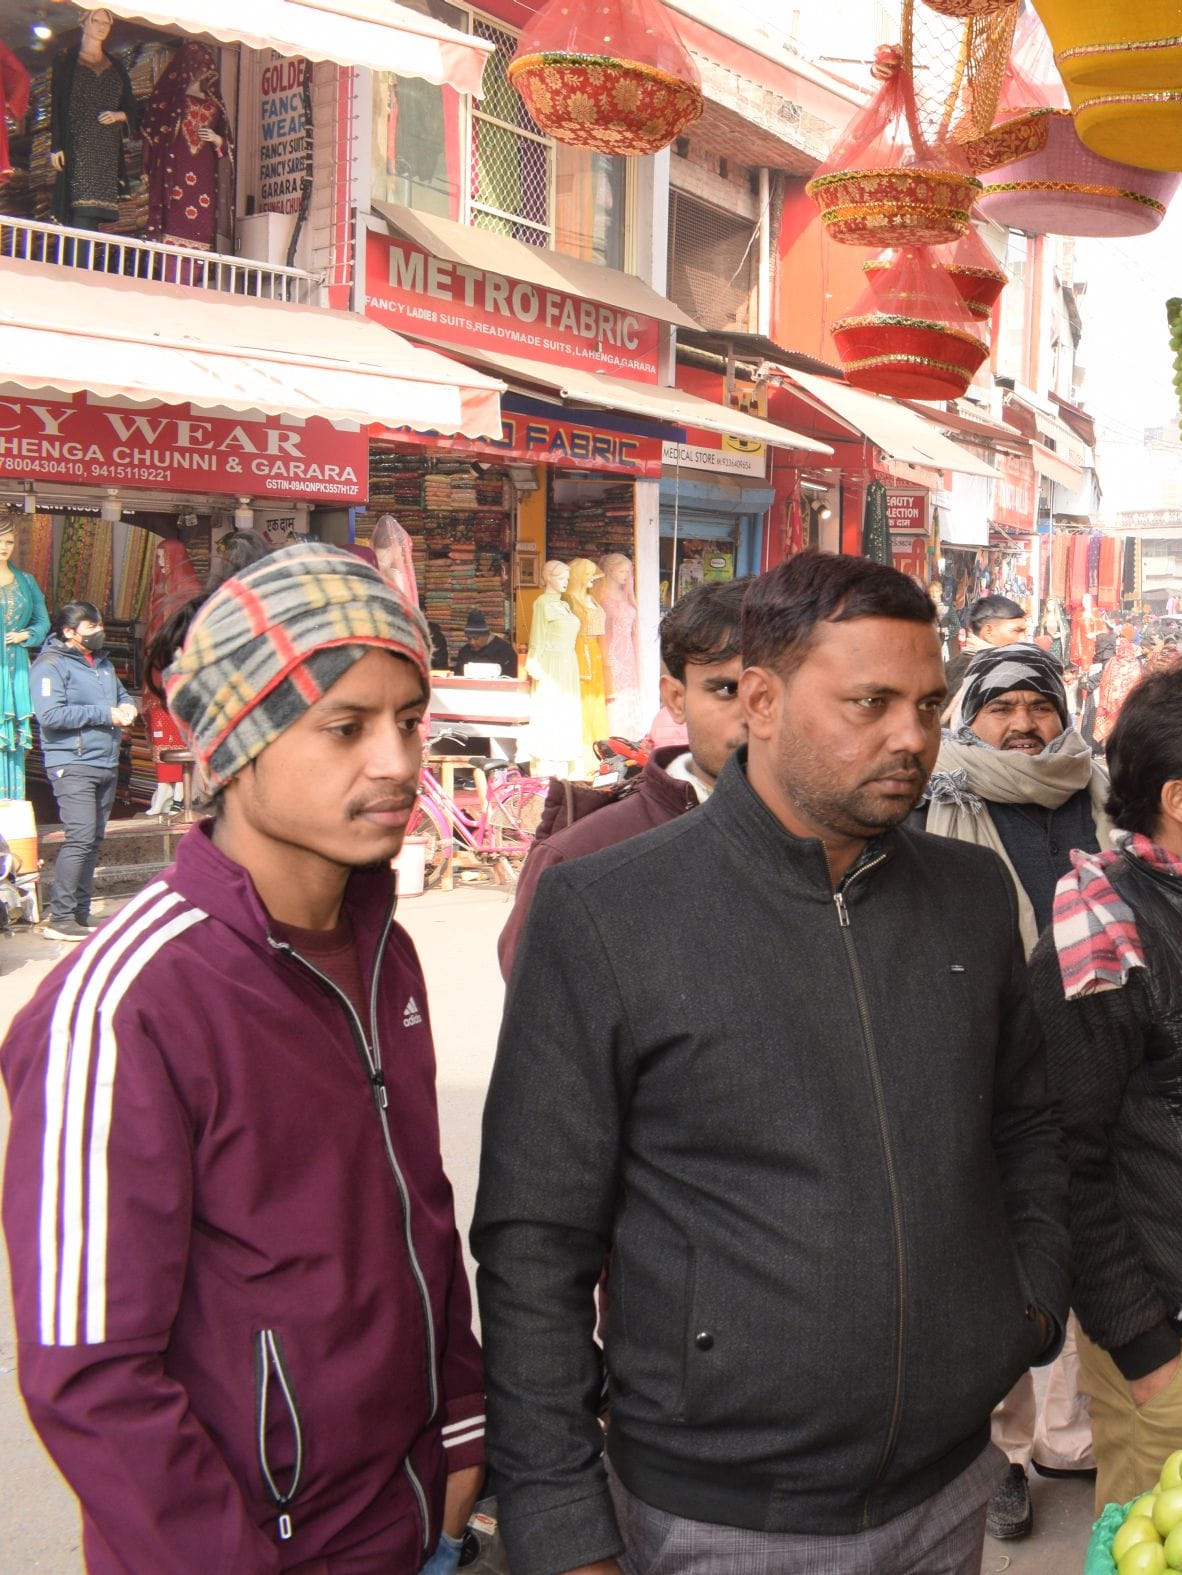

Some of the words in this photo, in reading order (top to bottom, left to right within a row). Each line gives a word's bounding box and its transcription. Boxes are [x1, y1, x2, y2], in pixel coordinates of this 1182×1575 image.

[261, 141, 288, 161] FANCY
[261, 160, 287, 180] FANCY
[262, 178, 297, 199] GARARA
[365, 295, 405, 314] FANCY
[406, 304, 438, 323] LADIES
[388, 245, 539, 323] METRO
[545, 292, 640, 350] FABRIC
[103, 412, 306, 458] WEAR
[525, 422, 640, 468] FABRIC
[112, 446, 217, 471] CHUNNI
[225, 456, 243, 474] &
[251, 458, 358, 483] GARARA
[663, 447, 694, 462] MEDICAL
[695, 450, 715, 465] STORE
[91, 463, 171, 482] 9415119221
